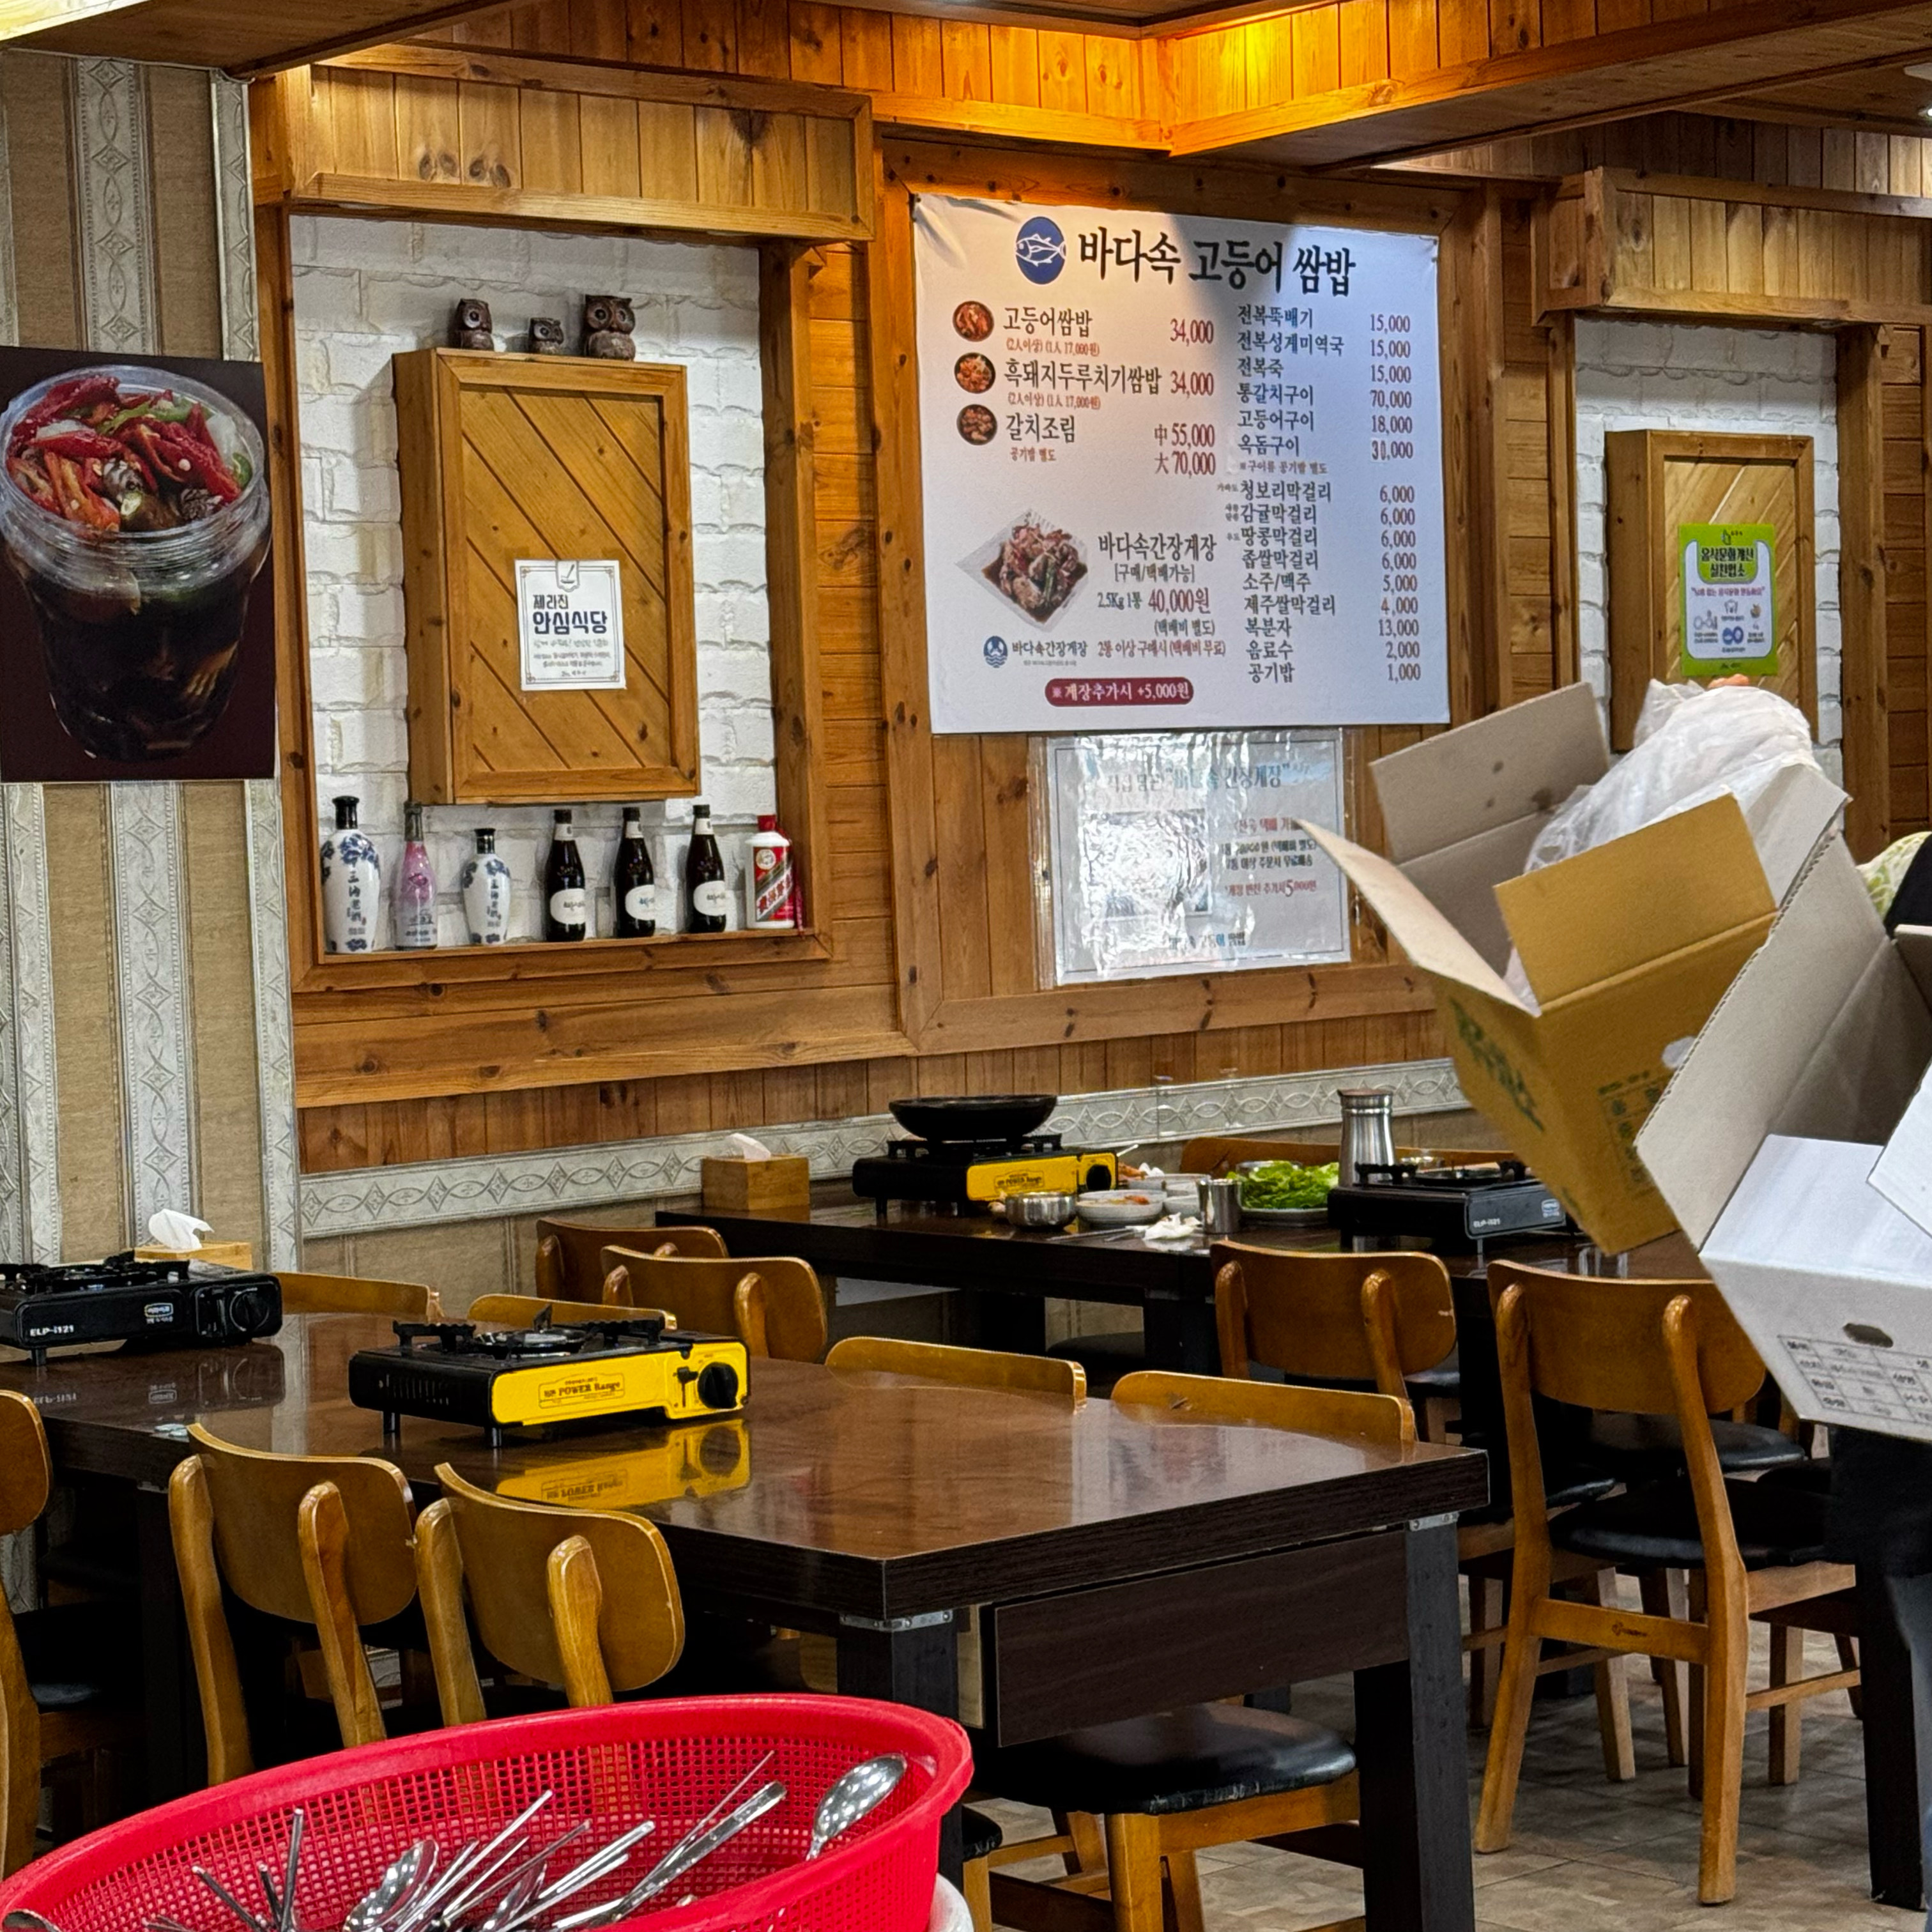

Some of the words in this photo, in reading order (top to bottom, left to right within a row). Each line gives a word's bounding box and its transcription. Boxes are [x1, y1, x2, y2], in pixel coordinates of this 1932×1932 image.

[1078, 226, 1181, 284] 바다속
[1188, 240, 1282, 293] 고등어
[1292, 245, 1356, 296] 쌈밥
[1003, 307, 1092, 338] 고등어쌈밥
[1170, 319, 1214, 346] 34,000
[1238, 303, 1312, 330] 전복뚝배기
[1370, 314, 1410, 334] 15,000
[1237, 330, 1344, 356] 전복성게미역국
[1370, 339, 1411, 359] 15,000
[1004, 358, 1162, 395] 흑돼지두루치기쌈밥
[1170, 372, 1214, 397] 34,000
[1237, 356, 1284, 379] 전복죽
[1370, 365, 1411, 385] 15,000
[1237, 383, 1314, 406] 통갈치구이
[1370, 390, 1412, 410] 70,000
[1006, 413, 1076, 443] 갈치조림
[1154, 426, 1167, 446] 中
[1171, 424, 1215, 450] 55,000
[1237, 410, 1314, 431] 고등어구이
[1372, 415, 1413, 434] 18,000
[1010, 447, 1035, 462] 공기밥
[1039, 447, 1057, 462] 별도
[1238, 435, 1300, 457] 옥돔구이
[1154, 452, 1169, 475] 大
[1172, 451, 1216, 479] 70,000
[1240, 479, 1331, 503] 청보리막걸리
[1380, 485, 1414, 504] 6,000
[1240, 502, 1316, 525] 감귤막걸리
[1381, 508, 1415, 527] 6,000
[1098, 532, 1216, 562] 바다속간장게장
[1241, 526, 1317, 548] 땅콩막걸리
[1381, 530, 1416, 549] 6,000
[1241, 549, 1319, 571] 좁쌀막걸리
[1382, 553, 1416, 572] 6,000
[1243, 573, 1312, 593] 소주/맥주
[1383, 574, 1417, 594] 5,000
[1148, 587, 1211, 616] 40,000원
[1243, 594, 1336, 616] 제주쌀막걸리
[1381, 597, 1418, 616] 4,000
[532, 611, 608, 635] 안심식당
[1154, 618, 1188, 637] (택배비
[1192, 618, 1215, 637] 별도)
[1245, 617, 1292, 637] 복분자
[1379, 619, 1419, 638] 13,000
[1012, 640, 1088, 657] 바다속간장게장
[1115, 640, 1137, 657] 이상
[1203, 640, 1226, 657] 무료)
[1246, 640, 1294, 661] 음료수
[1386, 641, 1420, 660] 2,000
[1248, 662, 1295, 683] 공기밥
[1388, 663, 1421, 683] 1,000
[1065, 682, 1132, 701] 게장추가시
[1138, 682, 1190, 701] +5,000원
